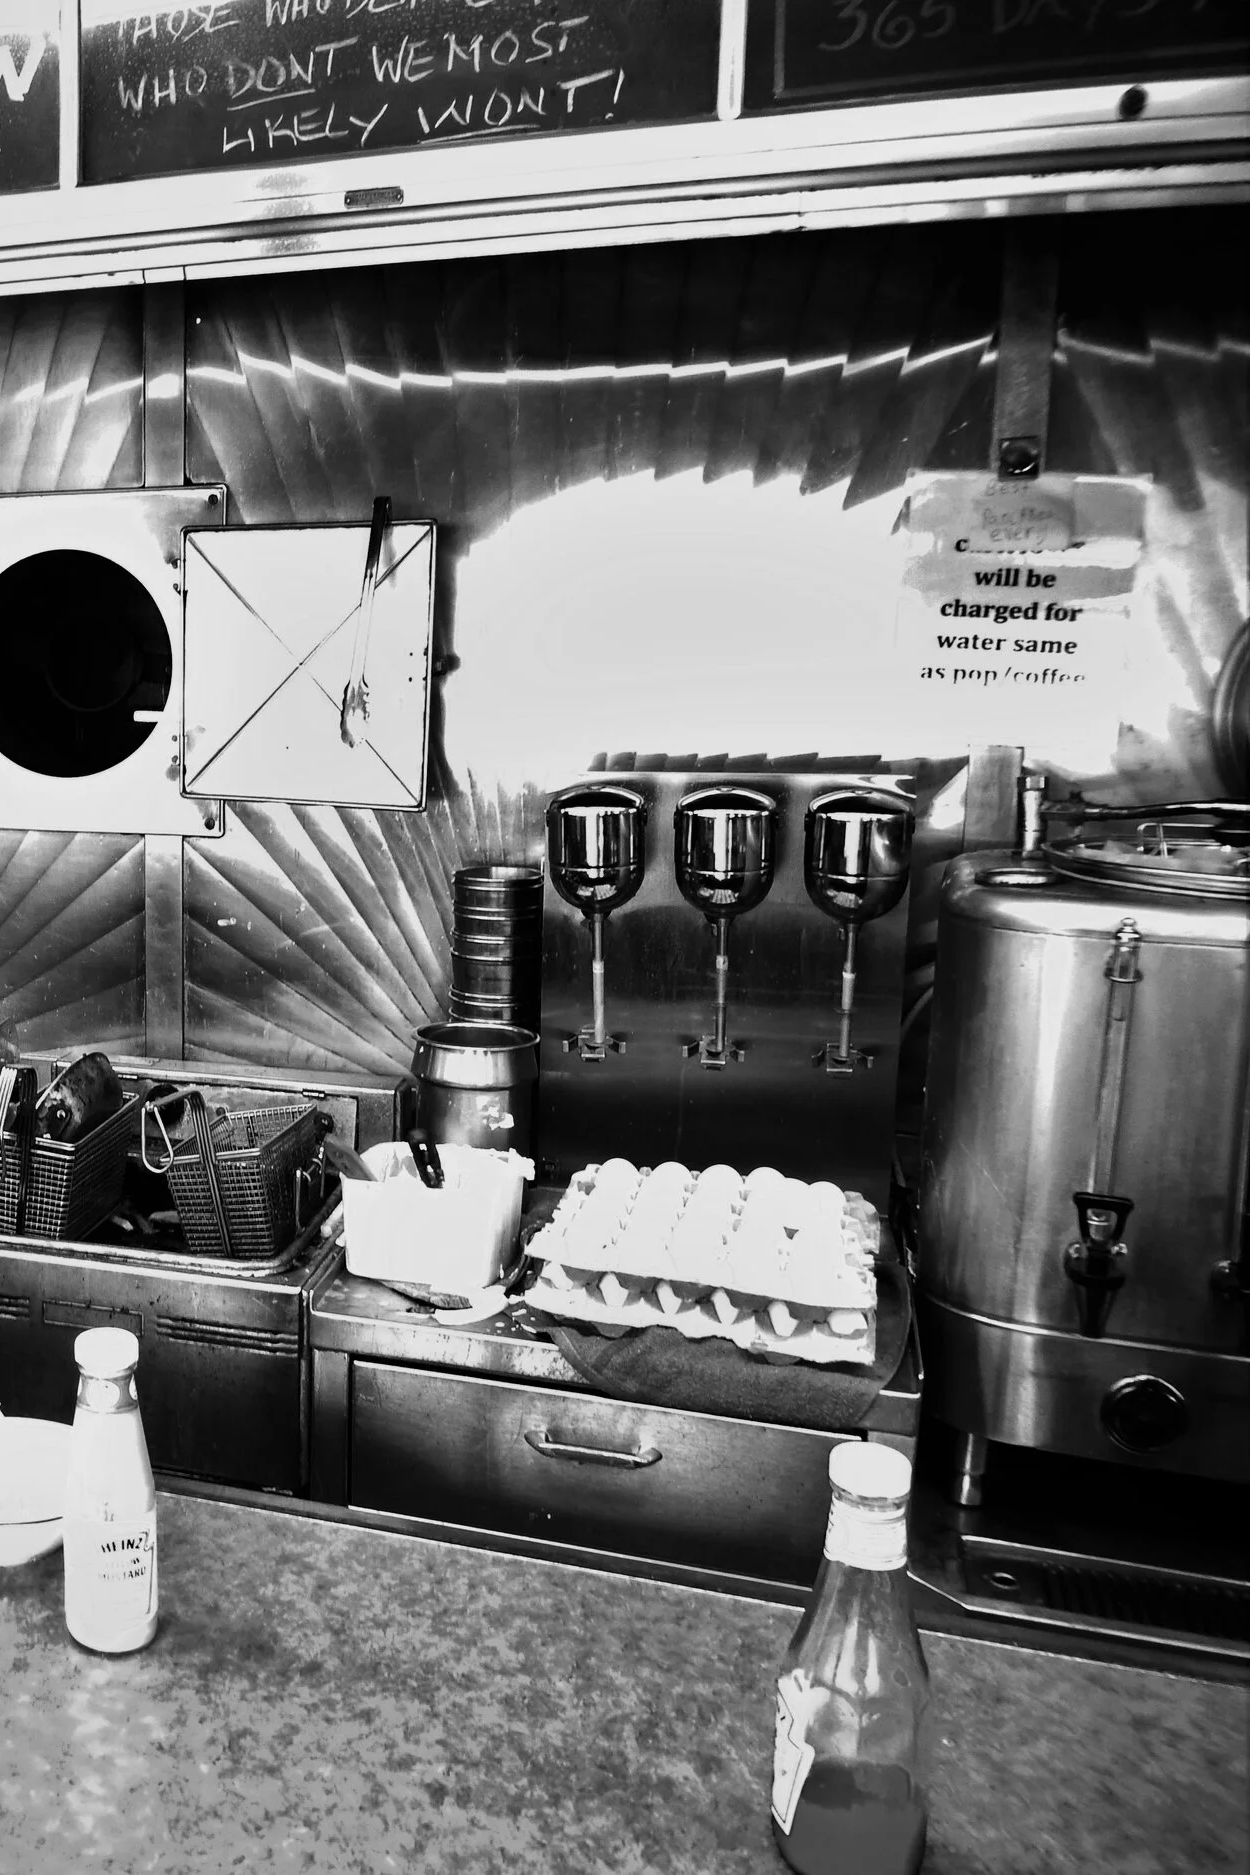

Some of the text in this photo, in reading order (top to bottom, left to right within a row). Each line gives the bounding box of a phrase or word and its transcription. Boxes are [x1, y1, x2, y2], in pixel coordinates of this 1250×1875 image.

[817, 0, 1161, 51] 365 DAY
[118, 15, 590, 112] WHO DONT WE MOST
[222, 101, 389, 154] LIKELY
[974, 567, 1057, 589] will be
[940, 598, 1083, 624] charged for
[937, 633, 1078, 655] water same
[920, 666, 946, 680] as
